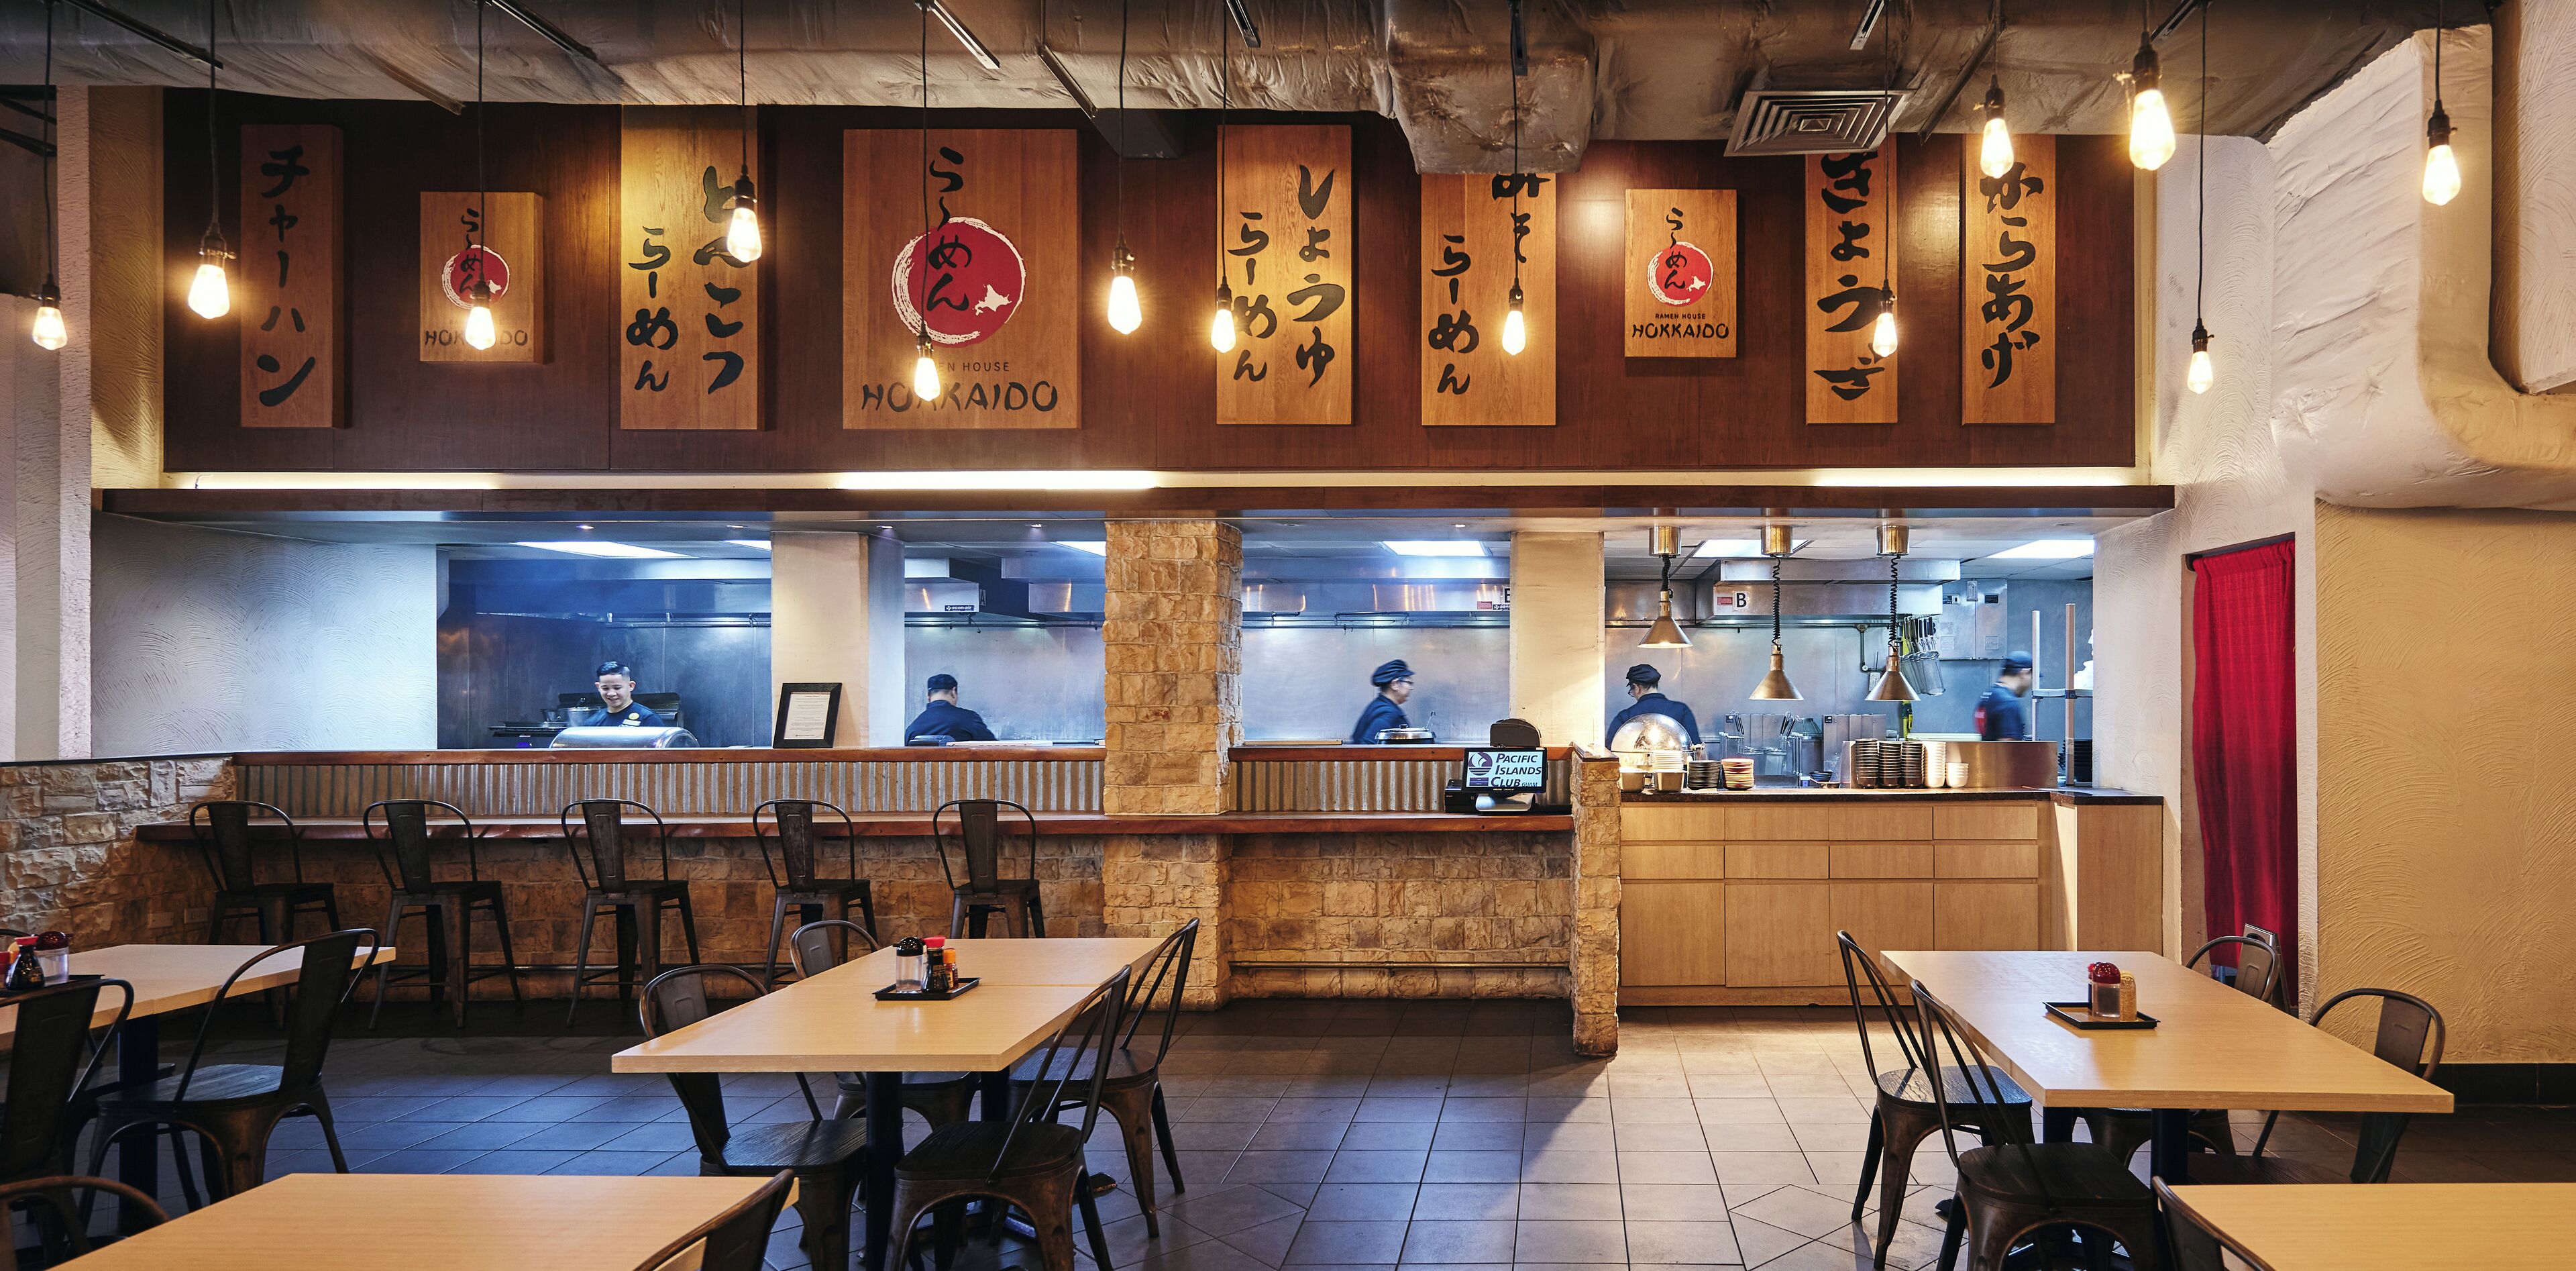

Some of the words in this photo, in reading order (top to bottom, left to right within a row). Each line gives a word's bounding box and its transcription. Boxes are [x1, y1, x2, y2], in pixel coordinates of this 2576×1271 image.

[257, 145, 316, 407] チャーハン
[926, 146, 973, 313] らーめん
[1287, 165, 1345, 389] しょうゆ
[1664, 207, 1688, 290] らーめん
[1980, 162, 2044, 389] からあげ
[626, 226, 679, 394] らーめん
[1228, 212, 1277, 382] らーめん
[1428, 234, 1480, 395] らーめん
[1632, 323, 1729, 339] HOKKAIDO
[963, 362, 1010, 372] HOUSE
[1736, 593, 1747, 608] B
[1491, 776, 1521, 787] CLUB
[1495, 765, 1542, 775] ISLANDS
[1496, 753, 1538, 763] PACIFIC
